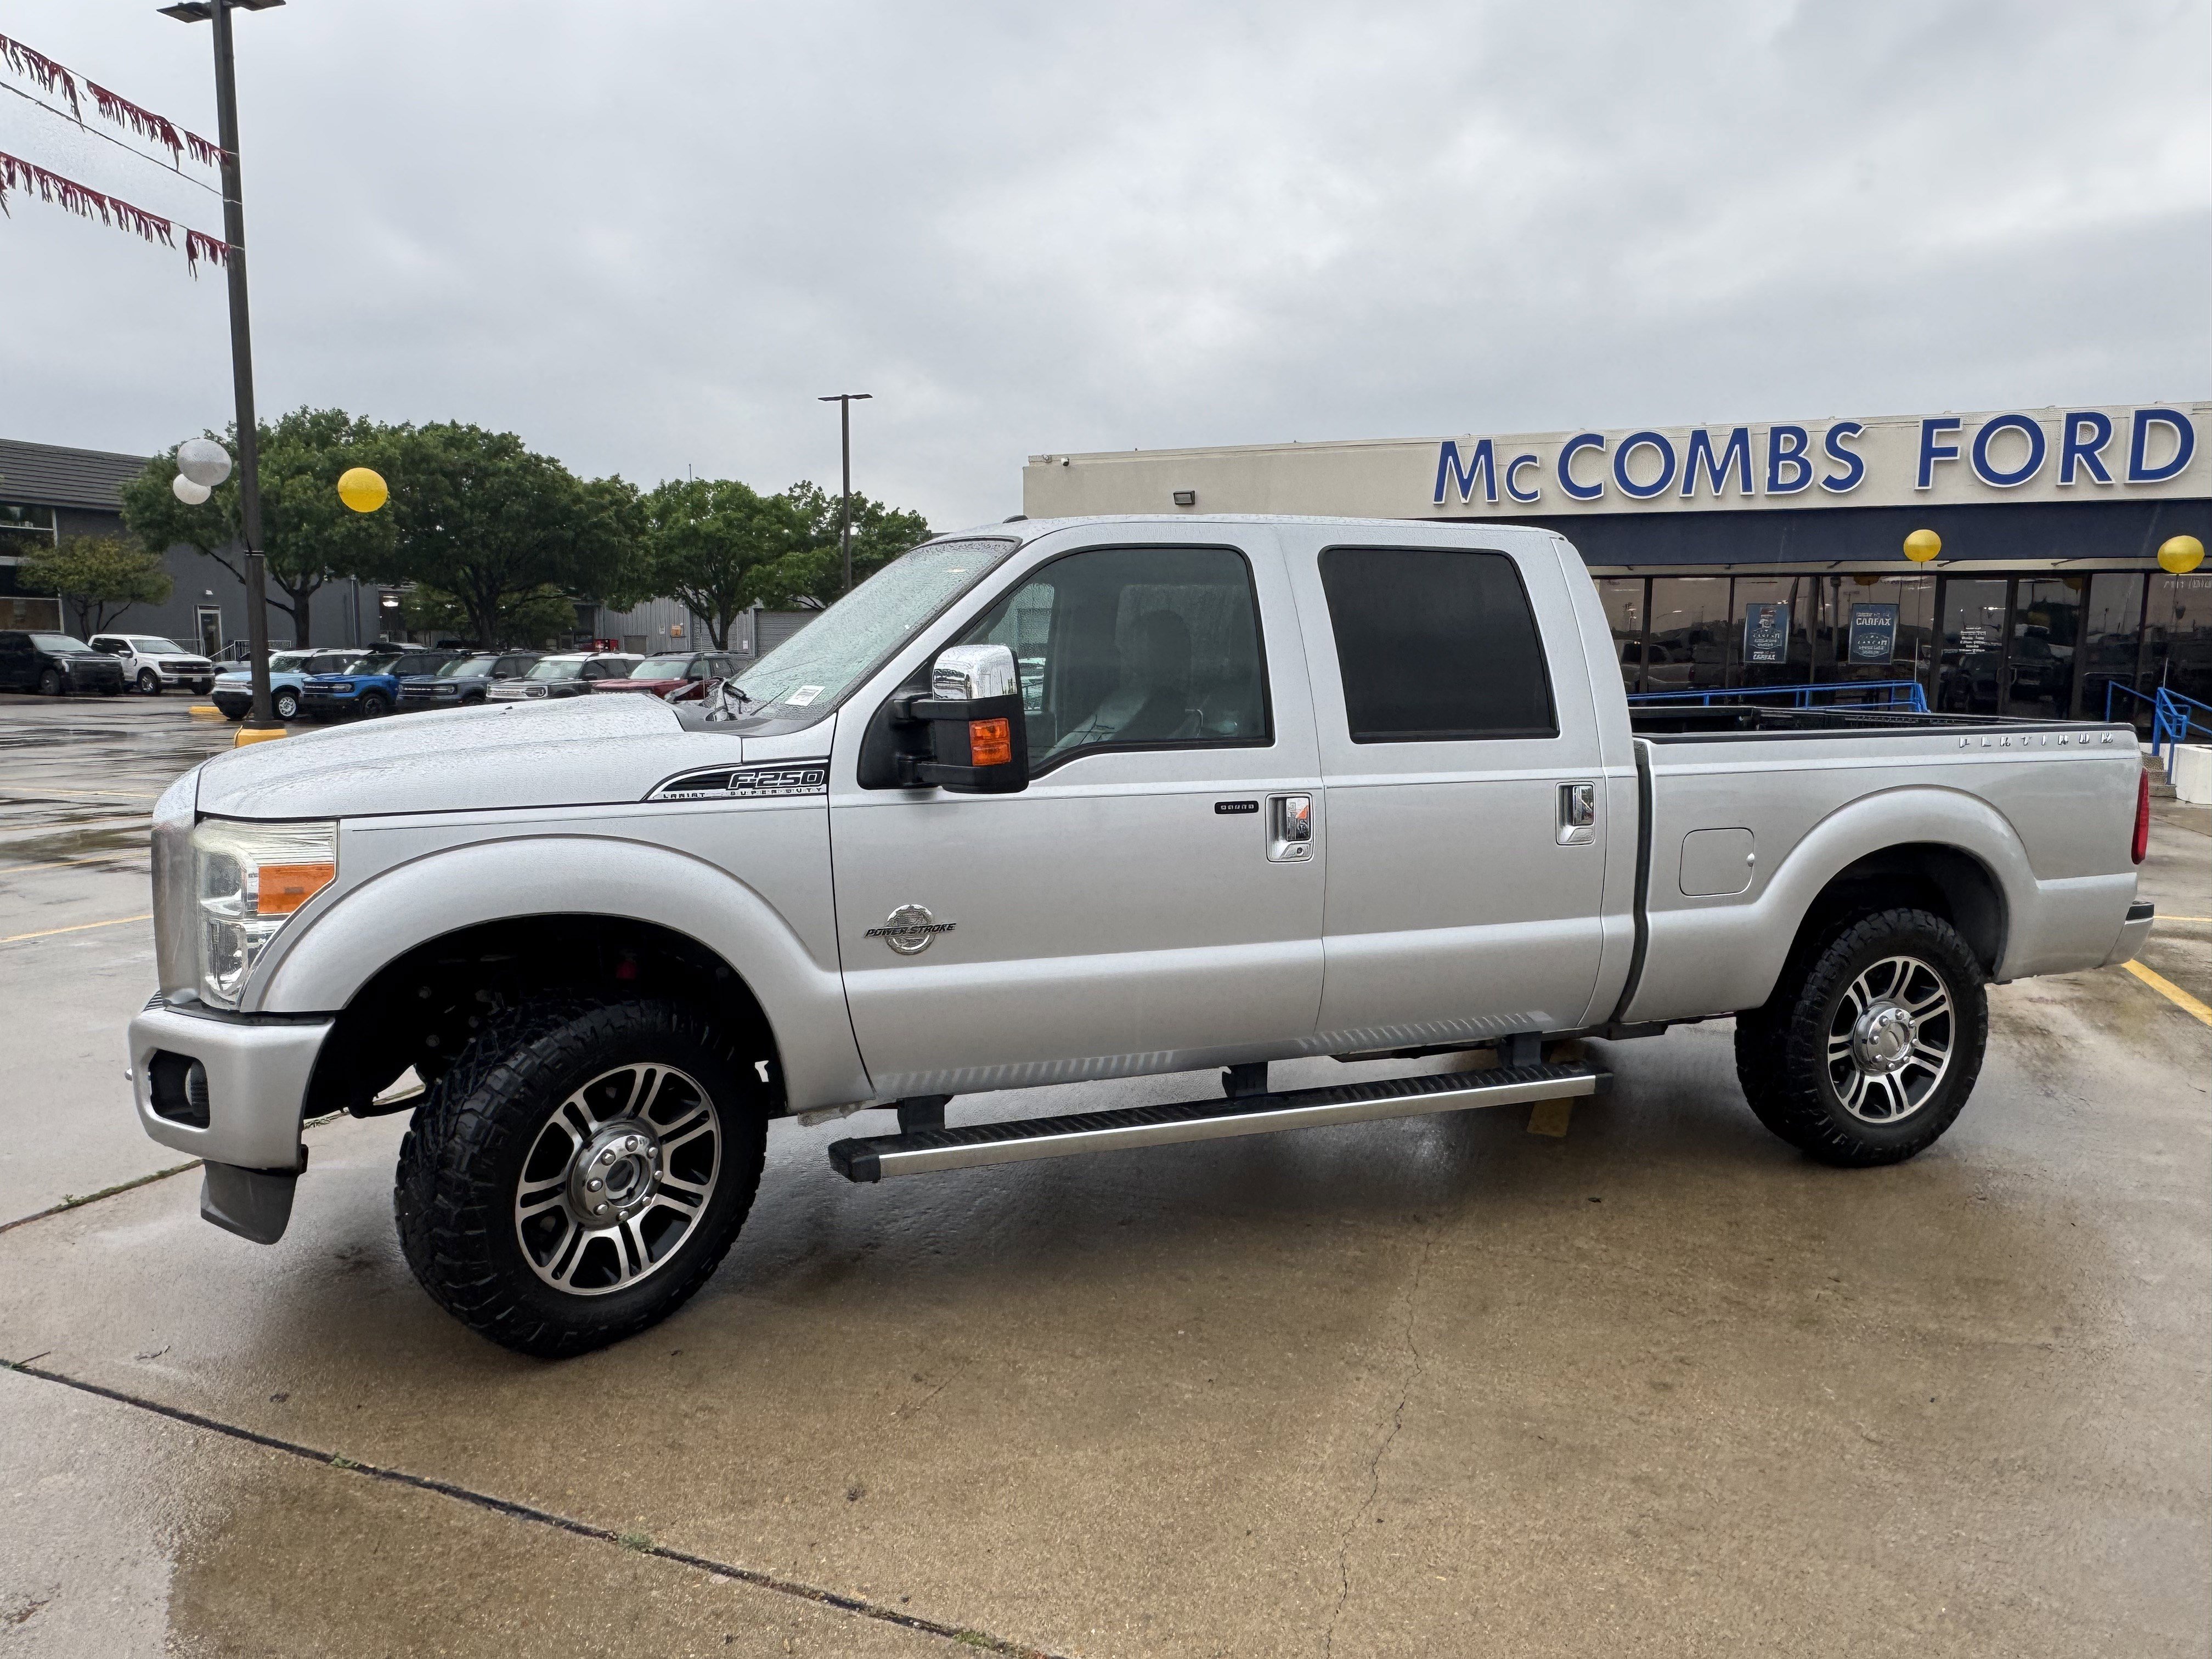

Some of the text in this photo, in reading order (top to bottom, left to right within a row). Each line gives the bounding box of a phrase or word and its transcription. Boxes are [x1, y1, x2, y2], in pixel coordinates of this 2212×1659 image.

[1914, 407, 2196, 491] FORD
[1959, 732, 2113, 748] PLATINUM
[728, 770, 825, 789] F-250
[865, 923, 956, 938] POWER STROKE
